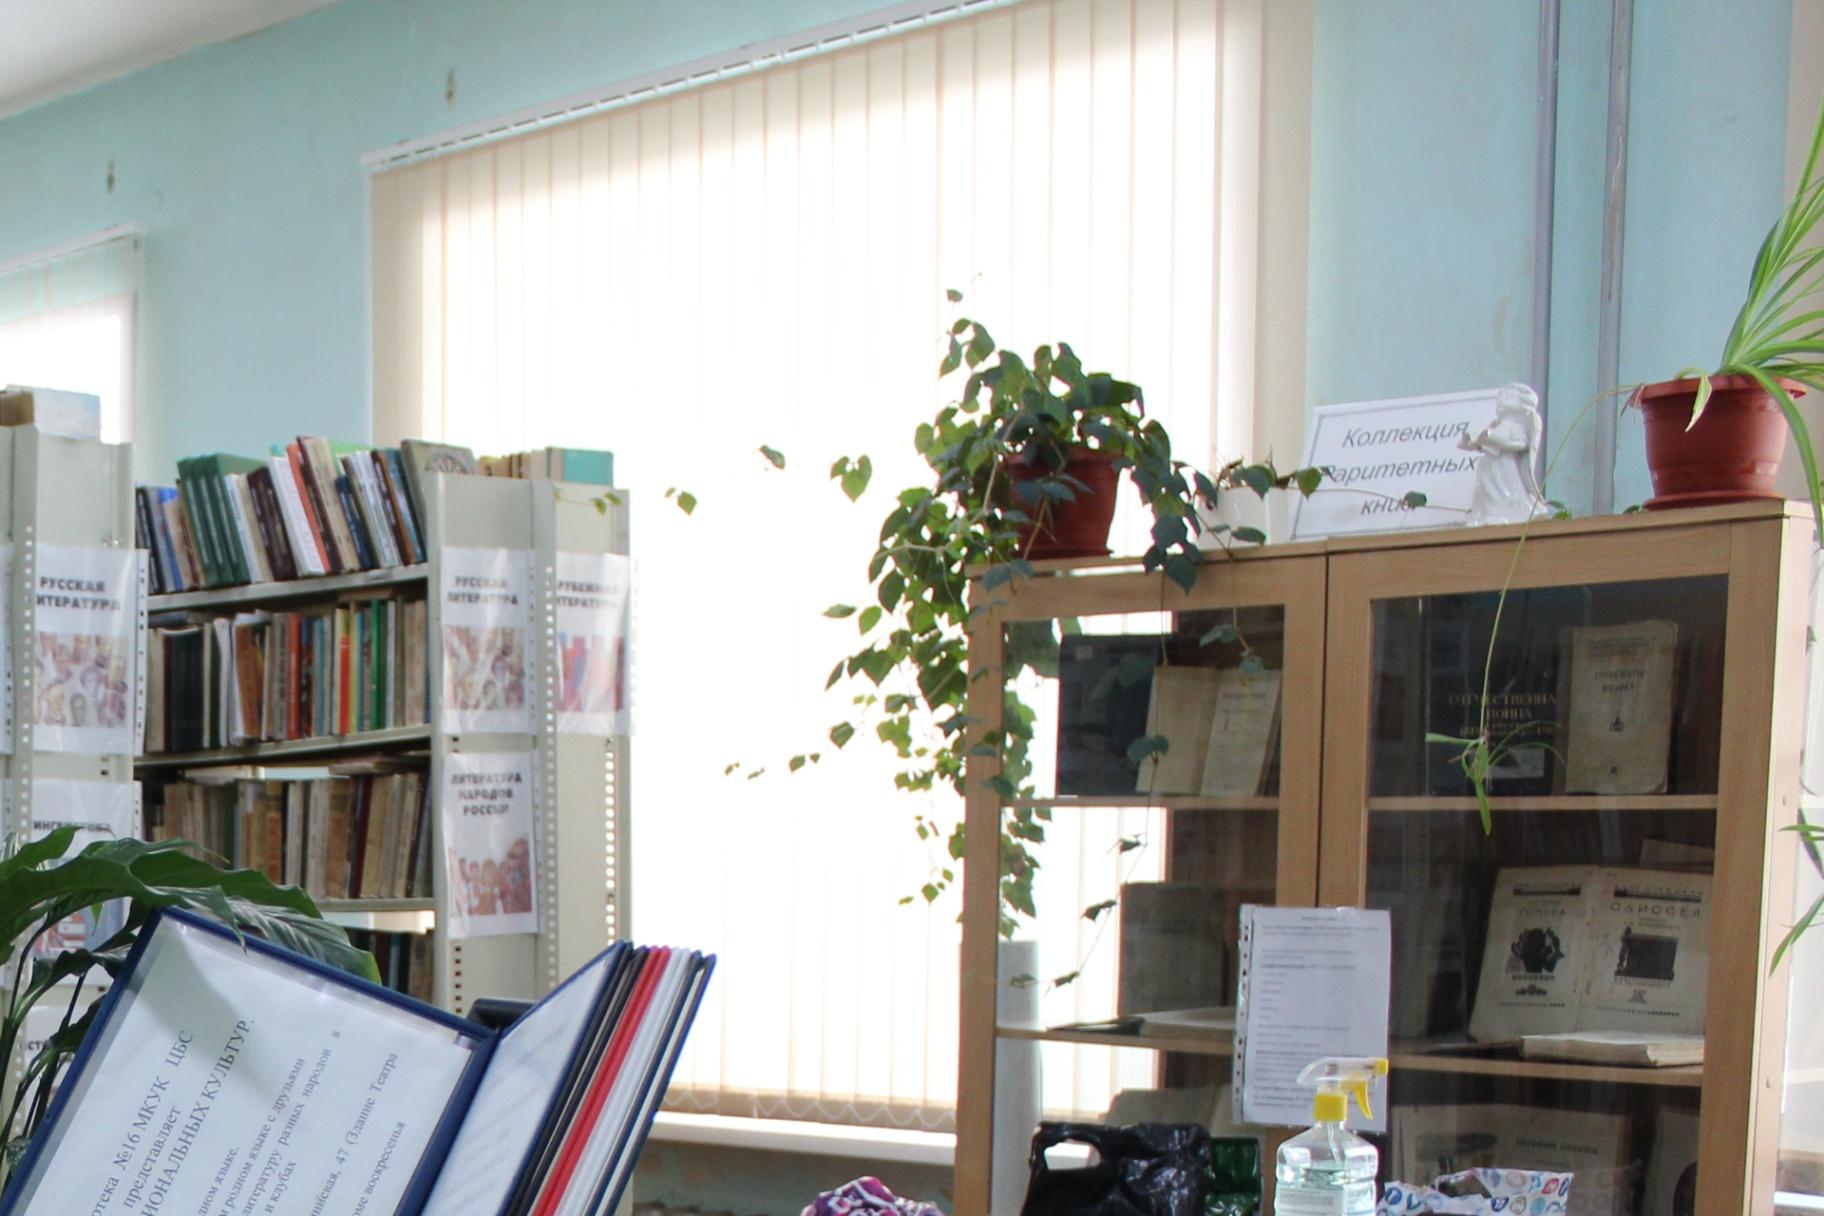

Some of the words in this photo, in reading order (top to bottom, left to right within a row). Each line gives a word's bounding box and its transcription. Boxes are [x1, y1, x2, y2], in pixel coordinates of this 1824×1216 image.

[1342, 421, 1469, 448] Коллекция
[36, 593, 120, 612] ИТЕРАТУРА
[40, 576, 105, 592] РУССКАЯ
[112, 1132, 140, 1170] №16
[132, 1075, 169, 1130] МКУК
[165, 1029, 193, 1066] ЦБС
[277, 1104, 305, 1146] разных
[301, 1049, 331, 1096] народов
[369, 1053, 398, 1091] Театра
[123, 1106, 180, 1208] представляет
[224, 1162, 252, 1208] родном
[248, 1124, 271, 1159] языке
[269, 1161, 296, 1201] клубах
[364, 1121, 405, 1194] воскресенья
